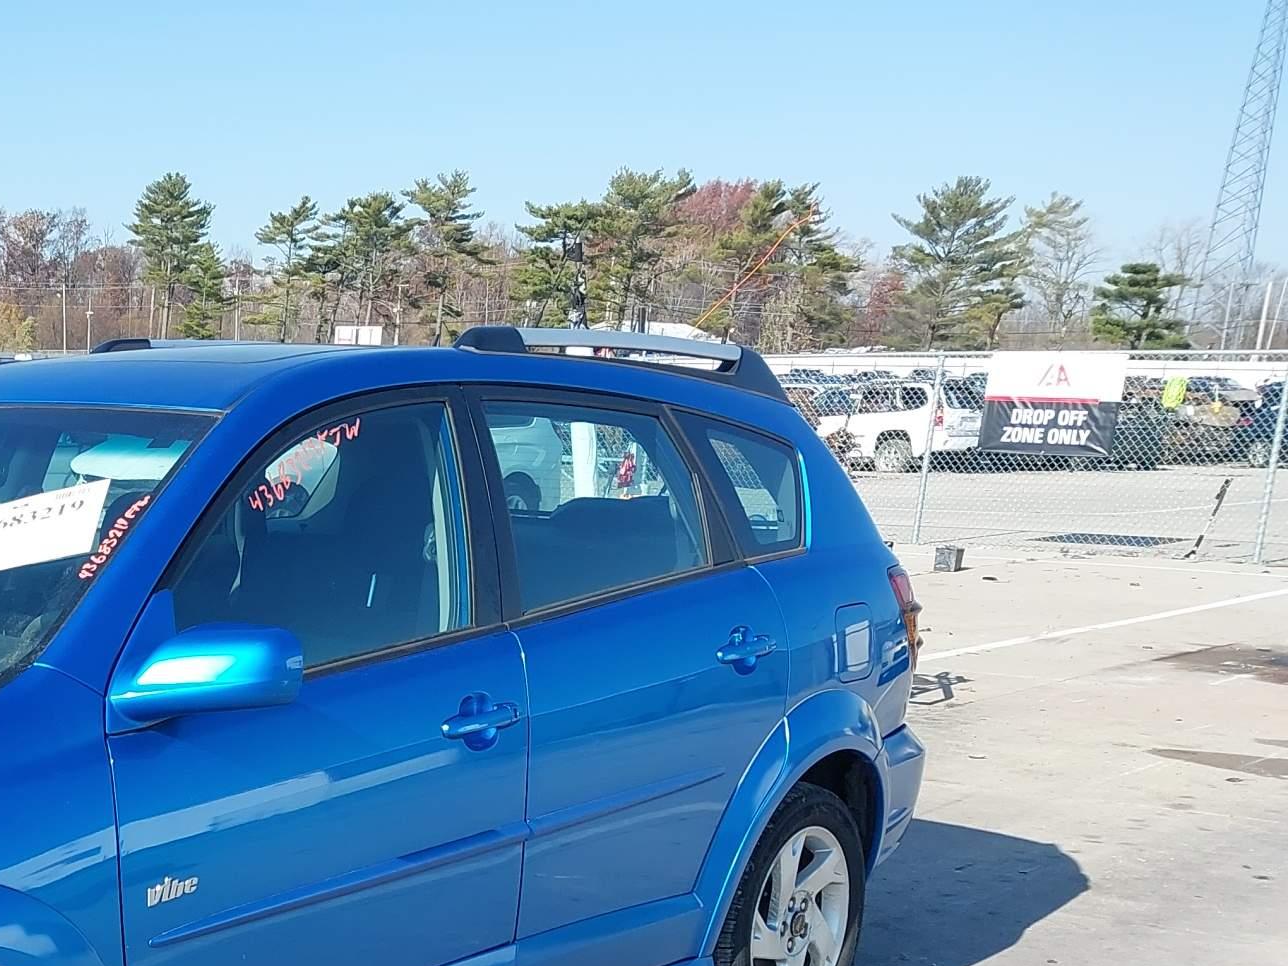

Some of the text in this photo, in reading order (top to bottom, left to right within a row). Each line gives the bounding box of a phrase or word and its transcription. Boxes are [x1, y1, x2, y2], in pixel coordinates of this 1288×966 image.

[1010, 408, 1089, 427] DROP OFF
[999, 426, 1091, 446] ZONE ONLY
